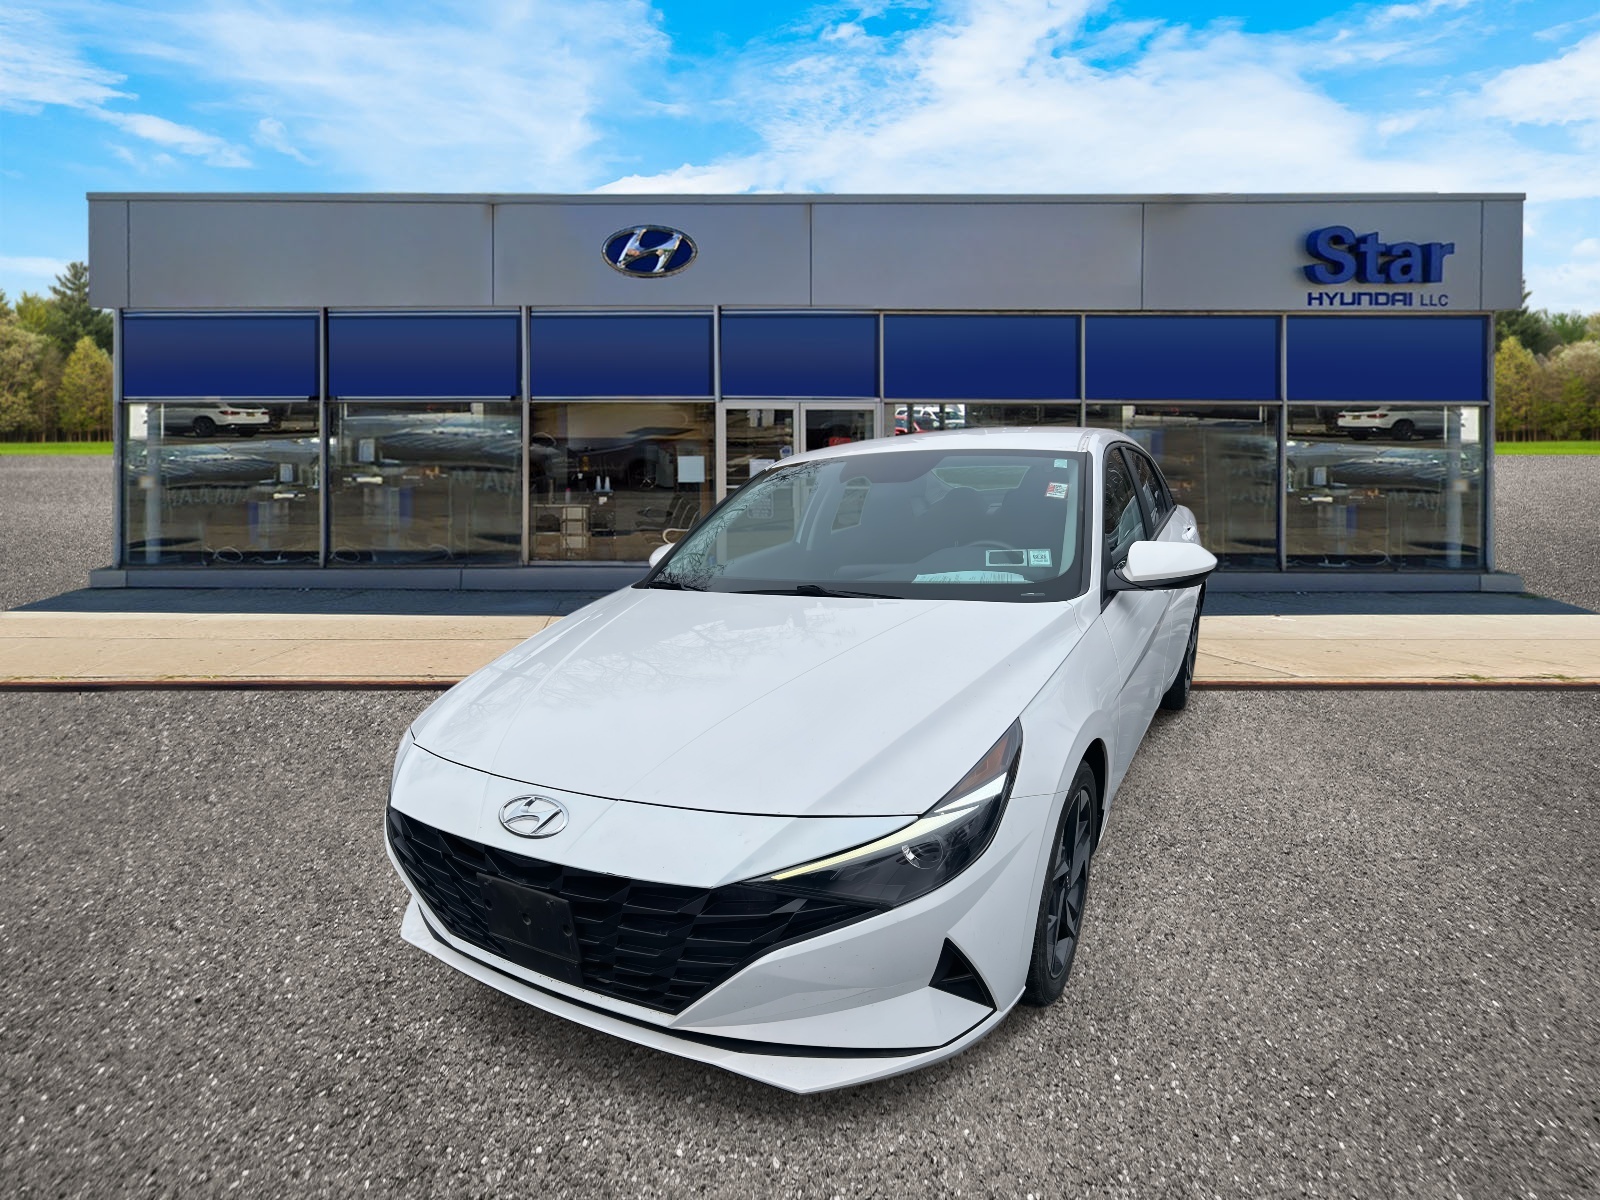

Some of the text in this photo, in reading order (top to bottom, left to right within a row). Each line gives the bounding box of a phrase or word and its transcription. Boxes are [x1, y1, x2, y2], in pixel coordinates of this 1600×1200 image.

[1303, 225, 1455, 285] Star
[1307, 292, 1449, 307] HYUNDAI LLC
